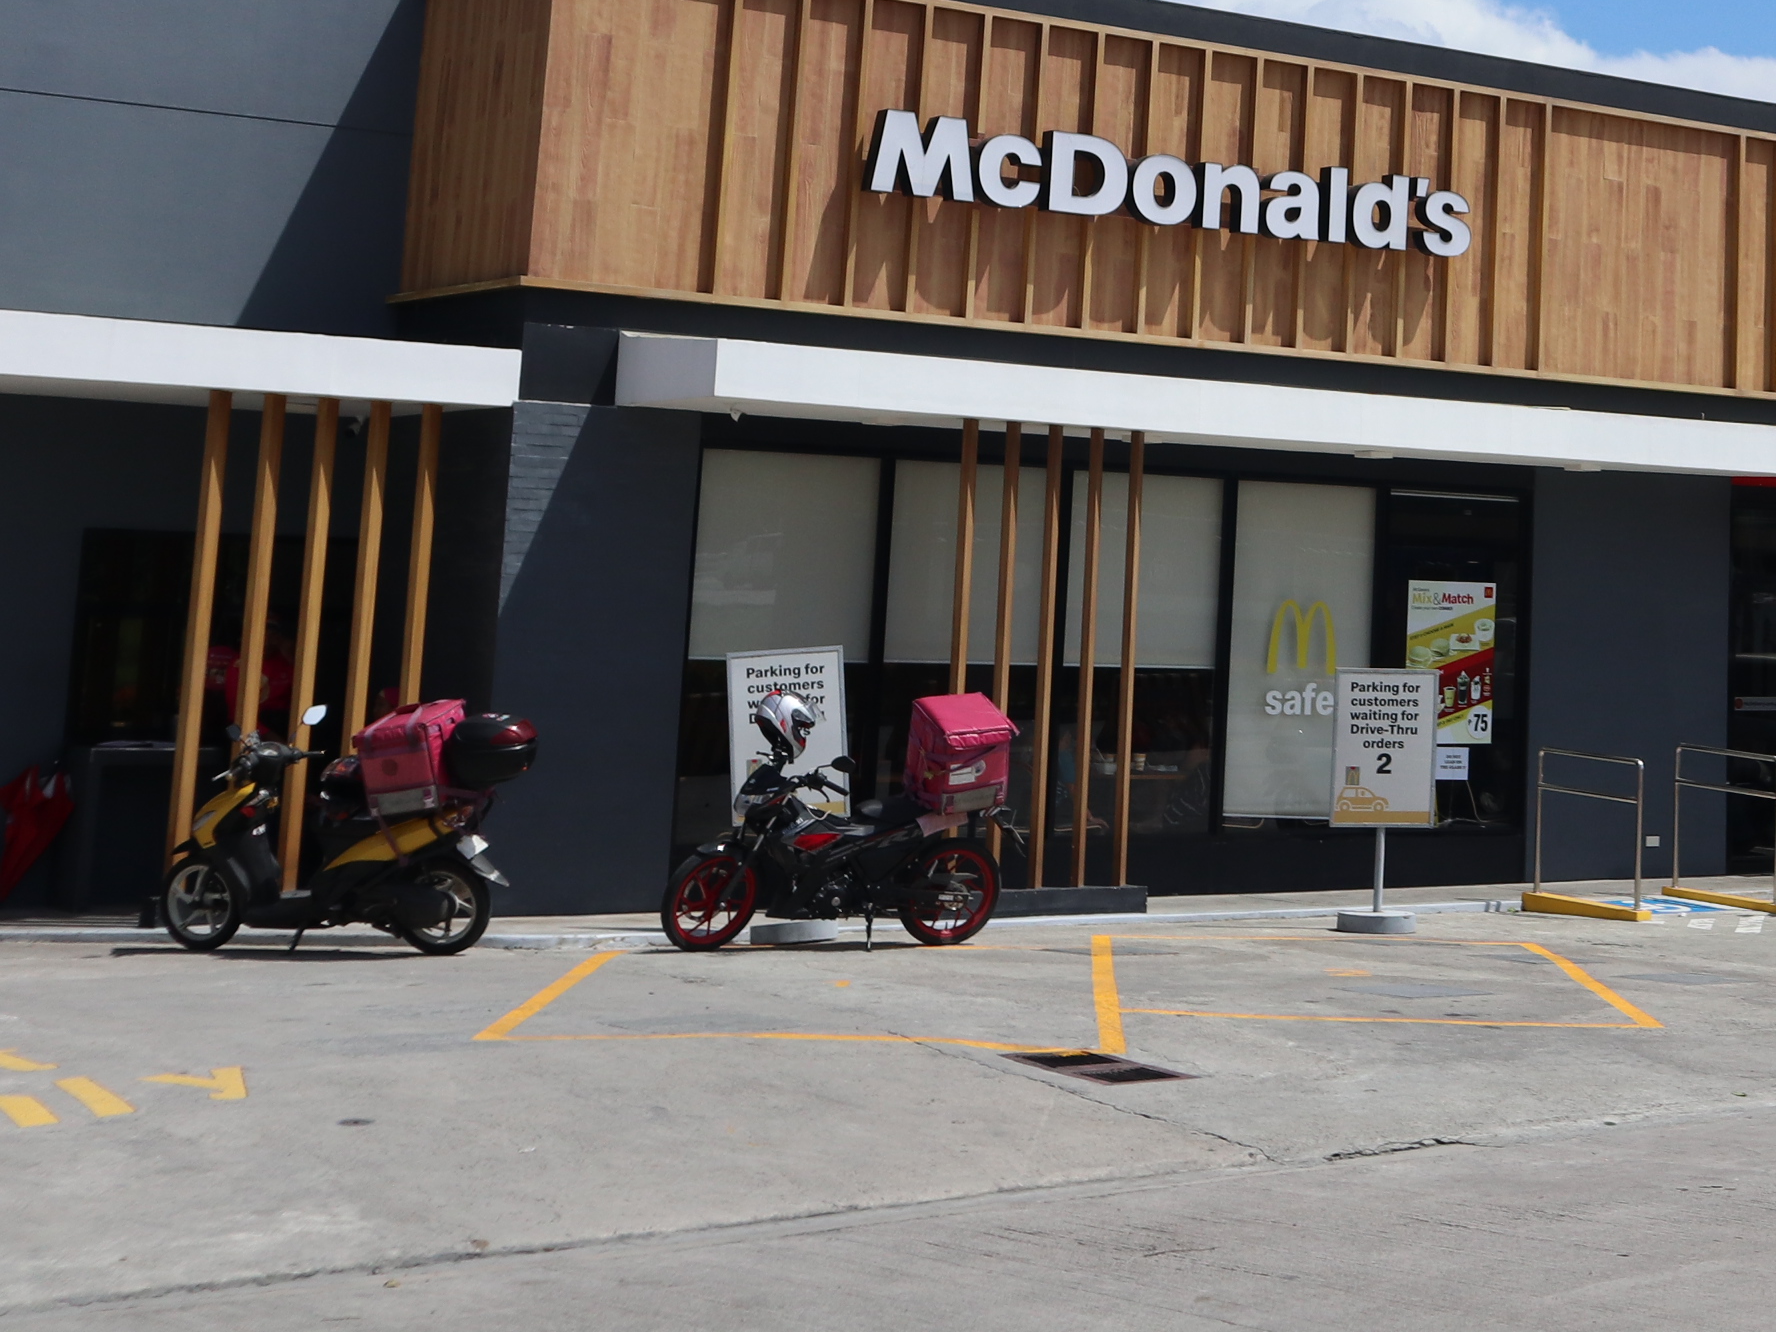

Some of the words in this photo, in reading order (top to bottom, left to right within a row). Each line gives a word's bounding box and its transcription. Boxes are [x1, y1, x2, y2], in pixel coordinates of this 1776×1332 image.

[869, 108, 1473, 258] McDonald's
[746, 664, 801, 679] Parking
[804, 663, 825, 675] for
[747, 680, 825, 694] customers
[1350, 681, 1400, 696] Parking
[1402, 682, 1421, 693] for
[1264, 682, 1335, 716] safe
[1350, 696, 1420, 708] customers
[1349, 709, 1398, 724] waiting
[1401, 710, 1420, 721] for
[1350, 723, 1418, 735] Drive-Thru
[1362, 738, 1405, 749] orders
[1375, 752, 1393, 775] 2
